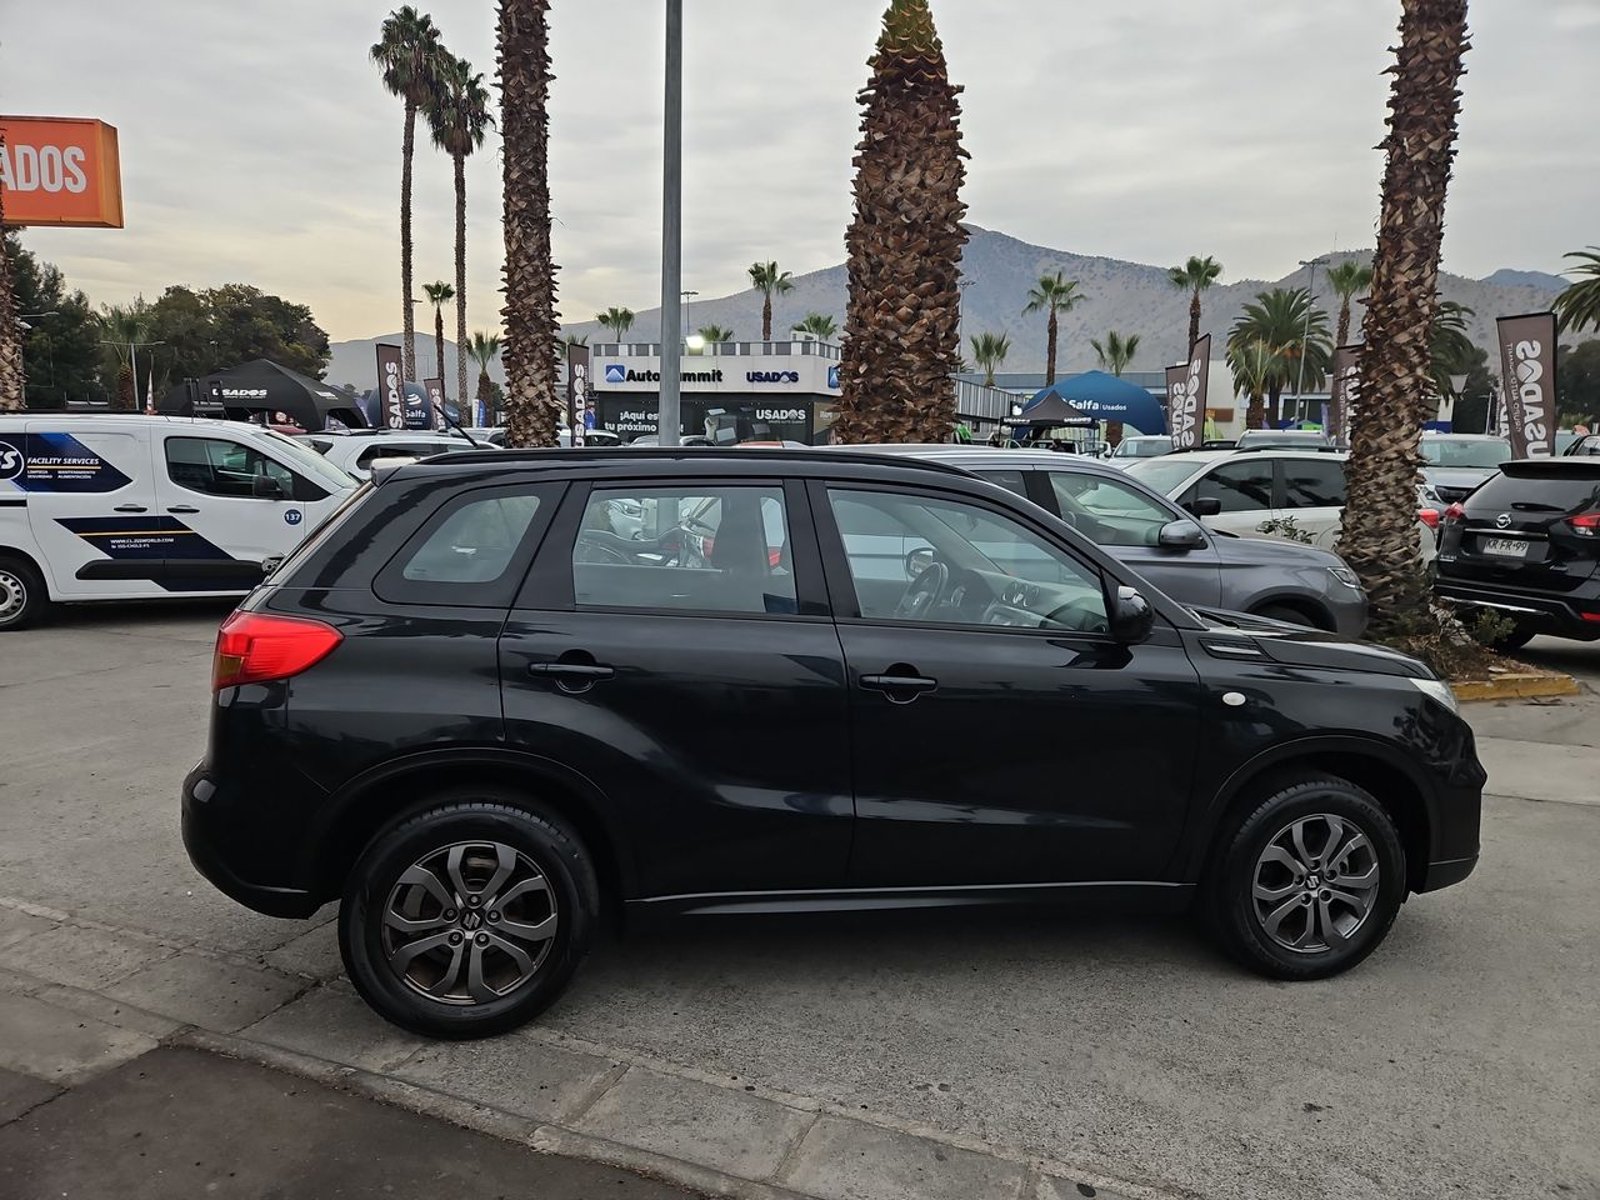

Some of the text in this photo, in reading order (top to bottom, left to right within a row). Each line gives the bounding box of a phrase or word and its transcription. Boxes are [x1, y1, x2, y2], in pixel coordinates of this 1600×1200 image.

[746, 371, 799, 384] USADOS
[1069, 400, 1099, 411] Salfa
[620, 410, 645, 422] ¡Aquí
[756, 409, 806, 421] USADOS
[605, 421, 657, 433] tu próximo
[27, 457, 62, 465] FACILITY
[285, 513, 301, 521] 137
